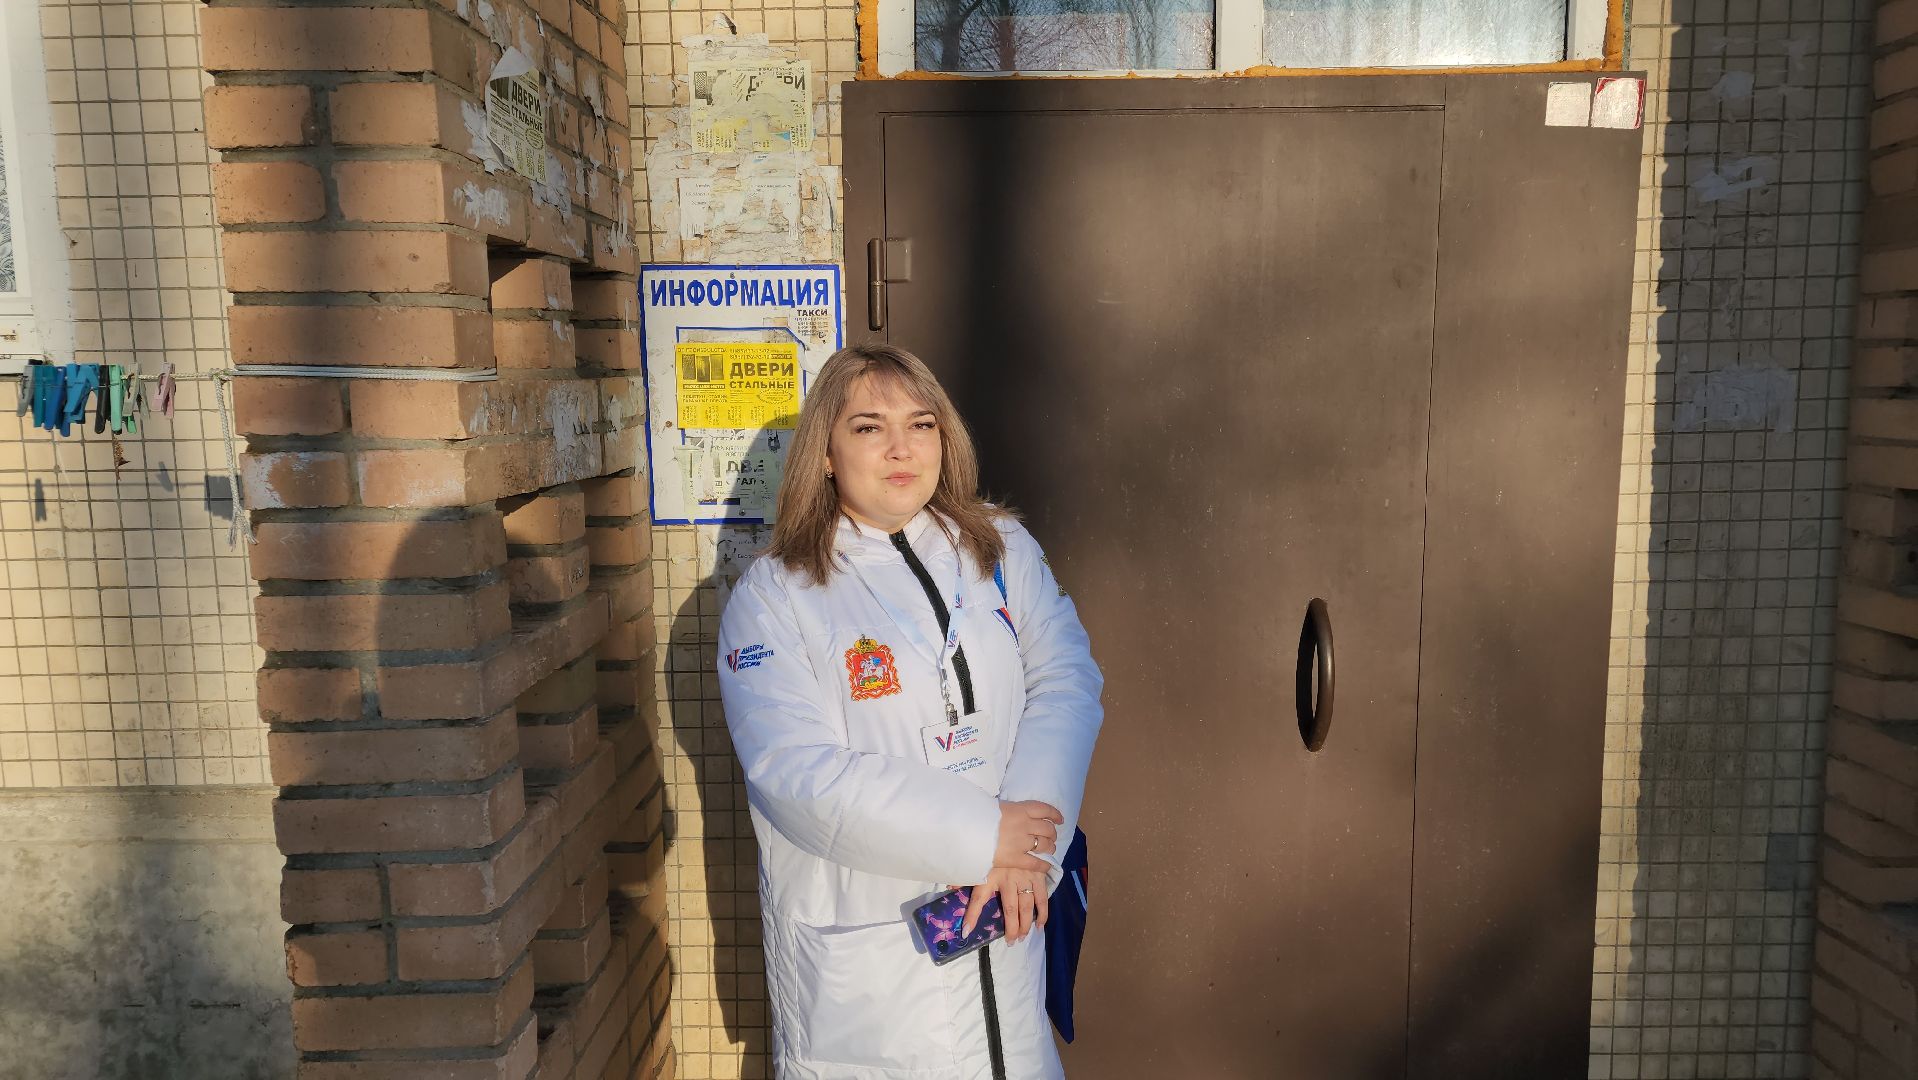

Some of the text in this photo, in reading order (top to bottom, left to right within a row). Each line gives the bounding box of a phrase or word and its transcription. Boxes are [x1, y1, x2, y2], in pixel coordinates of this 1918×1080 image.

[511, 80, 542, 117] ДВЕРИ
[511, 105, 543, 133] СТАЛЬНЫЕ
[650, 278, 829, 308] ИНФОРМАЦИЯ
[797, 309, 828, 317] ТАКСИ
[729, 362, 794, 379] ДВЕРИ
[729, 380, 795, 389] СТАЛЬНЫЕ
